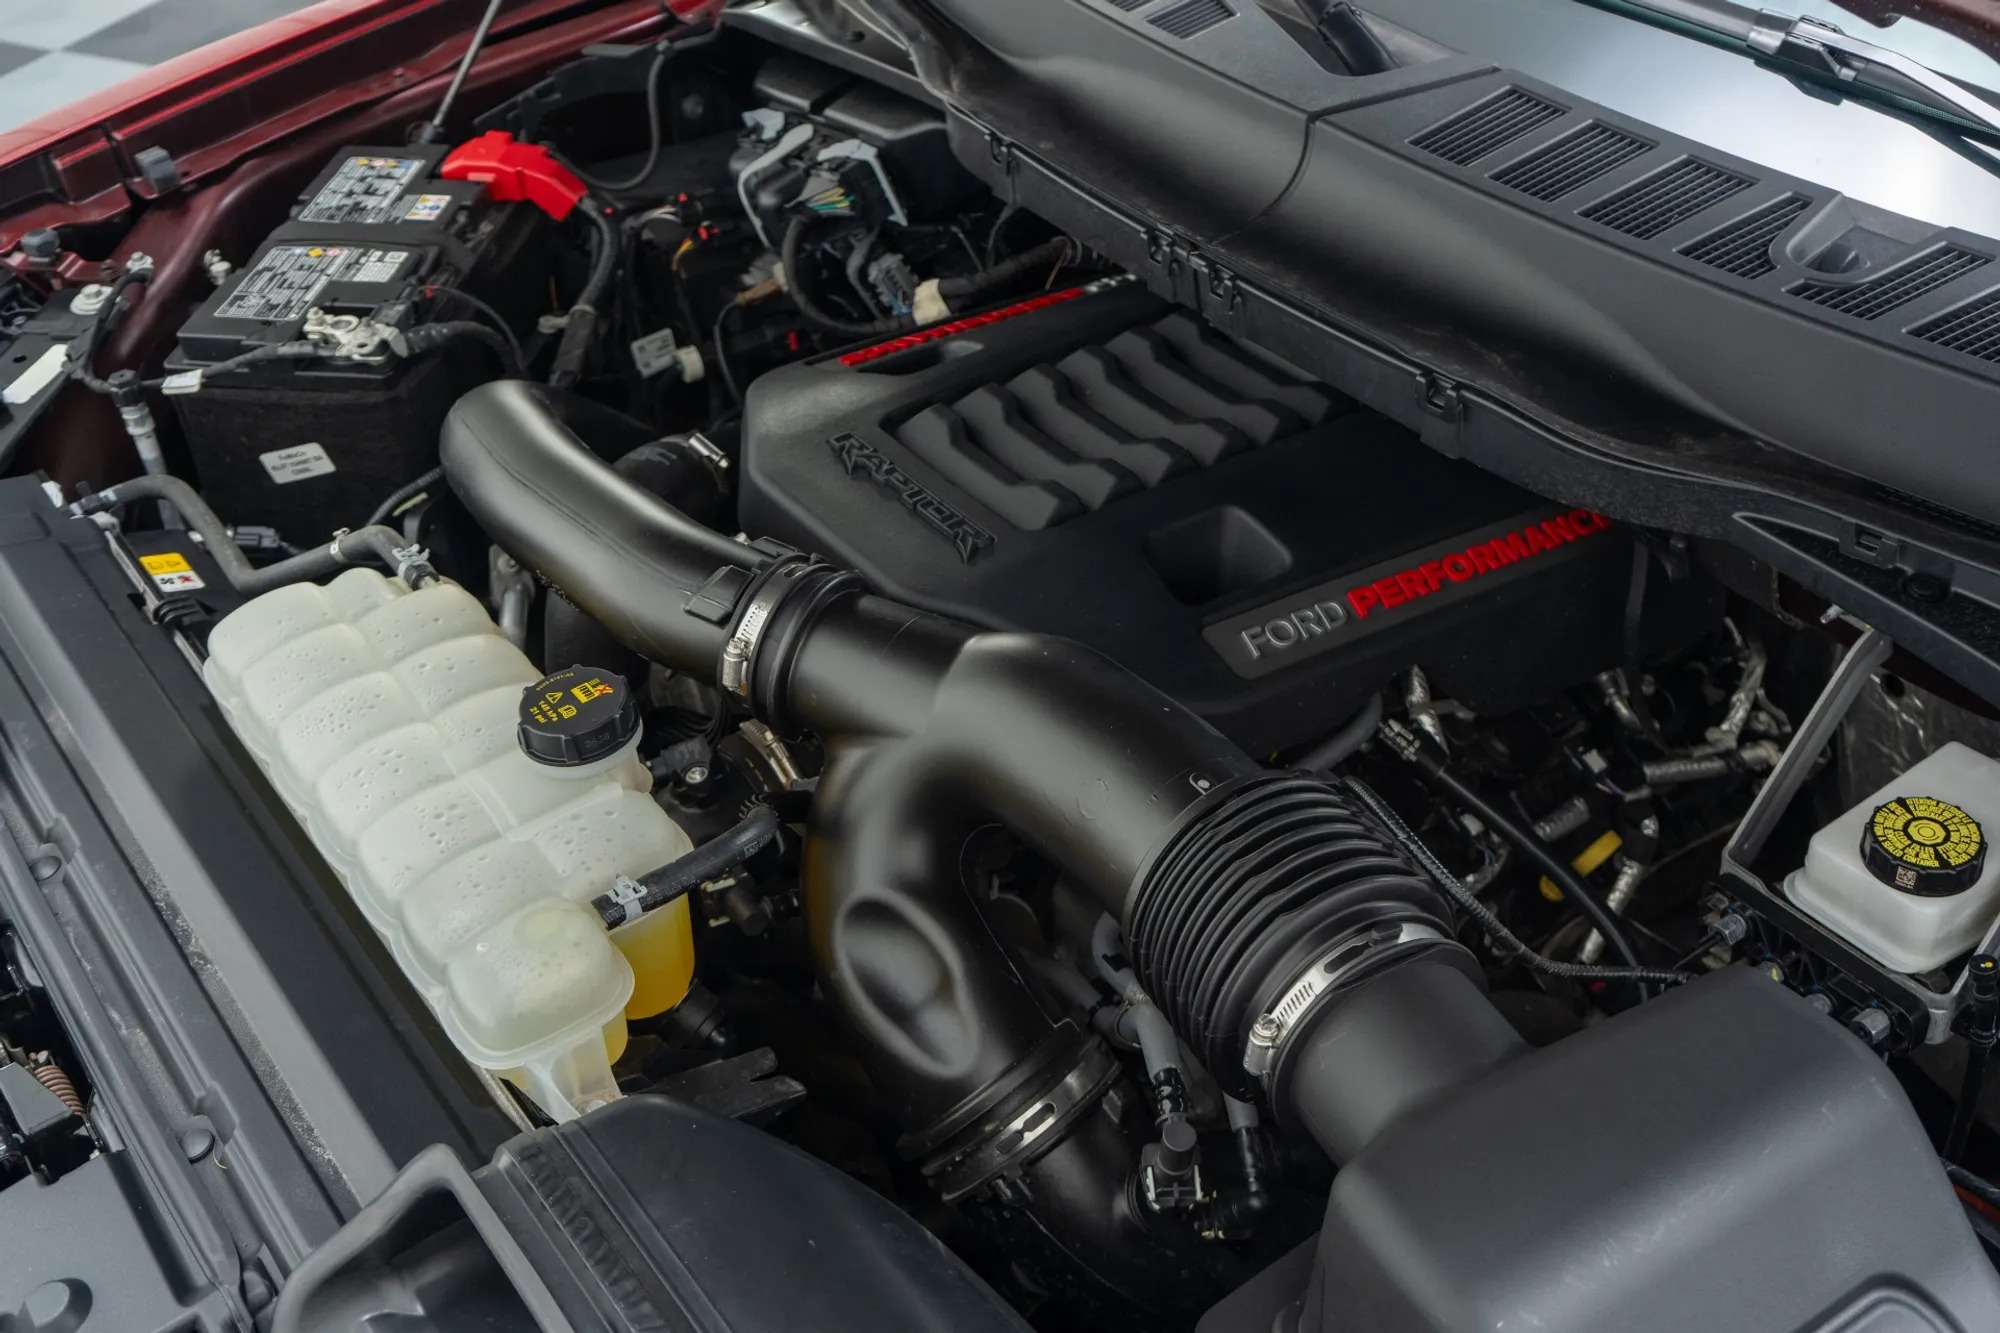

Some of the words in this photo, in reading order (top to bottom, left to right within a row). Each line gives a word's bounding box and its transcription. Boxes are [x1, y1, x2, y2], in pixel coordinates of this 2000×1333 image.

[826, 432, 997, 566] RAPTOR
[1240, 600, 1348, 660] FORD
[1902, 853, 1940, 868] CONTAINER
